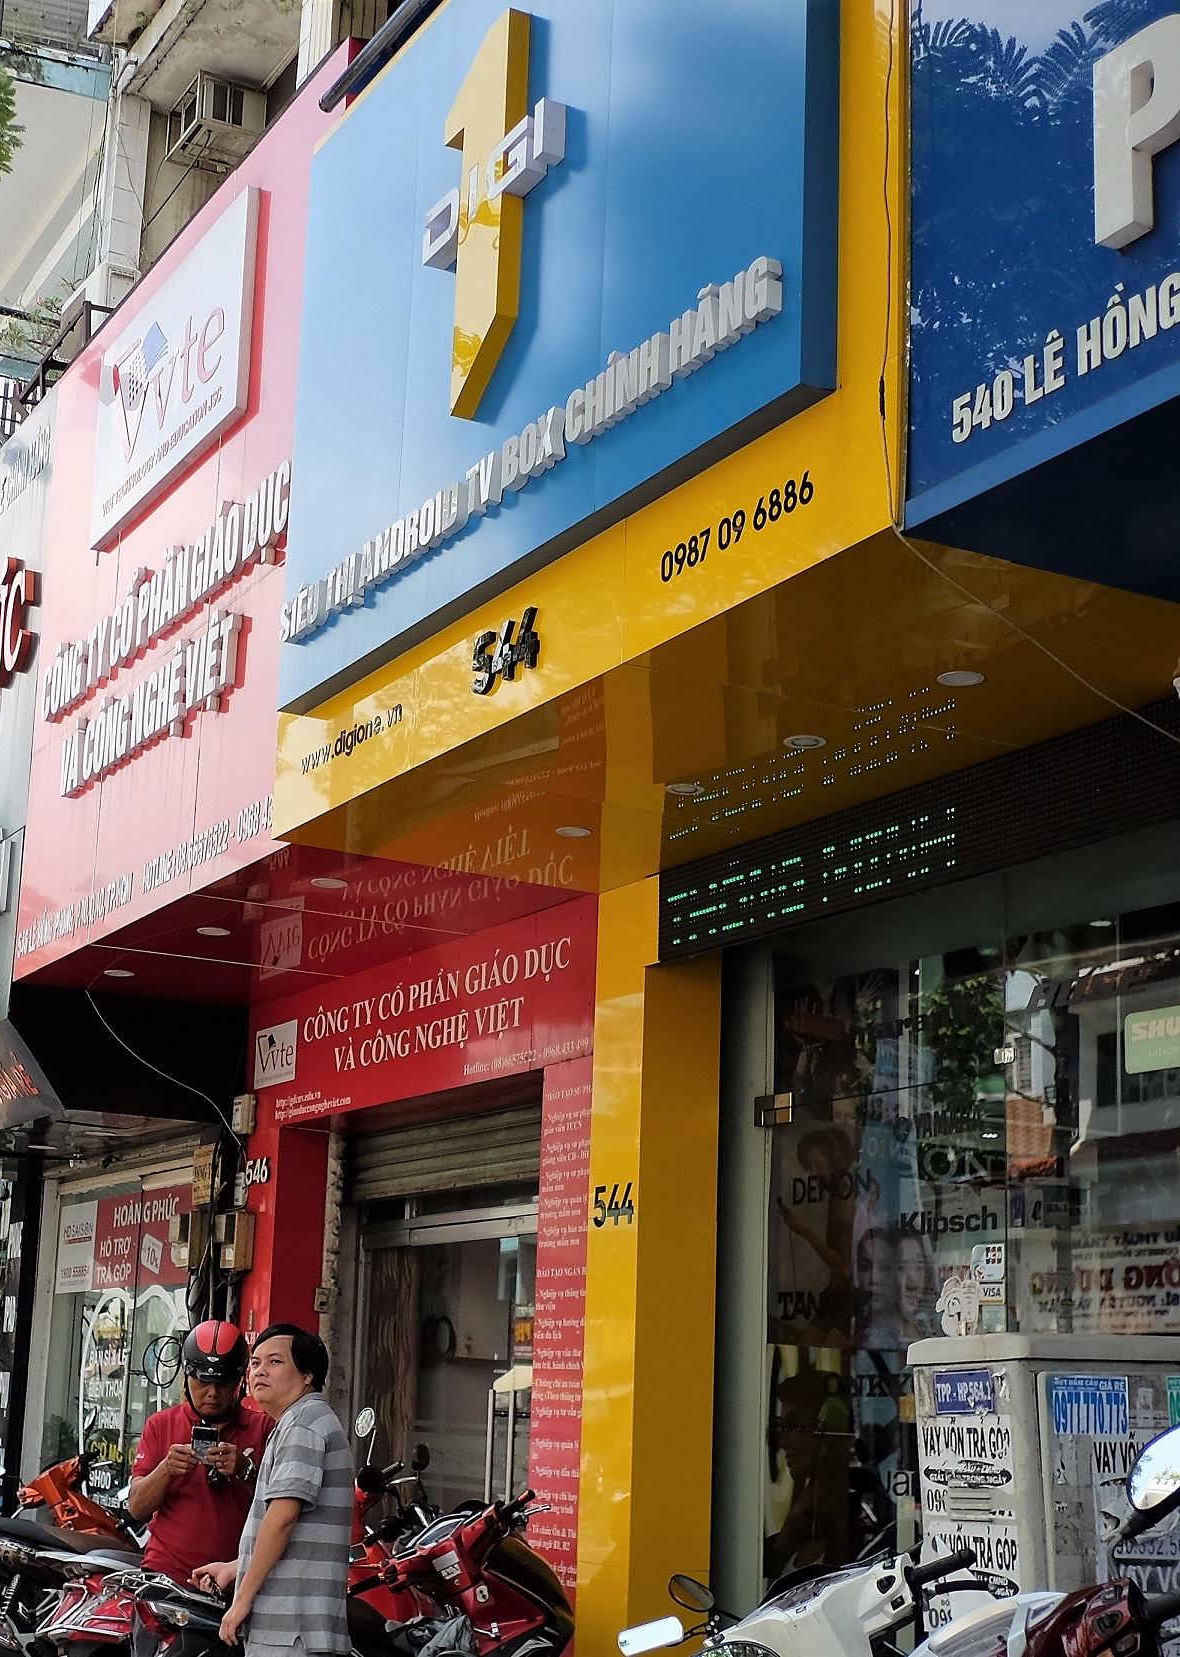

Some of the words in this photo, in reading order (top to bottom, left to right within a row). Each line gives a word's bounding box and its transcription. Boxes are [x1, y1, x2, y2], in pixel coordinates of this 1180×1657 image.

[422, 97, 567, 272] DIGI
[951, 383, 1015, 444] 540
[1020, 330, 1067, 406] LÊ
[325, 552, 365, 613] THỊ
[357, 481, 468, 588] ANDROID
[466, 450, 502, 516] TV
[501, 405, 566, 493] BOX
[565, 351, 671, 445] CHÍNH
[669, 255, 783, 378] HÃNG
[659, 532, 712, 583] 0987
[717, 511, 746, 552] 09
[753, 471, 815, 531] 6886
[41, 641, 89, 724] CÔNG
[85, 614, 114, 688] TY
[109, 566, 148, 668] CỔ
[135, 544, 194, 650] PHẦN
[190, 500, 246, 604] GIÁO
[241, 459, 290, 565] DỤC
[471, 606, 541, 696] 544
[60, 716, 89, 799] VÀ
[82, 693, 132, 782] CÔNG
[129, 638, 188, 750] NGHỆ
[183, 610, 242, 715] VIỆT
[303, 1004, 349, 1044] CÔNG
[353, 998, 377, 1028] TY
[378, 982, 405, 1019] CỔ
[408, 967, 460, 1012] PHẦN
[464, 947, 519, 997] GIÁO
[524, 937, 572, 982] DỤC
[333, 1036, 356, 1073] VÀ
[360, 1020, 411, 1063] CÔNG
[413, 1009, 470, 1050] NGHỆ
[475, 996, 525, 1041] VIỆT
[463, 1062, 490, 1076] Hotline:
[566, 1120, 582, 1132] TCCN
[245, 1156, 269, 1186] 546
[792, 1168, 873, 1207] DENON
[113, 1198, 151, 1228] HOÀNG
[151, 1193, 180, 1222] PHÚC
[592, 1180, 635, 1229] 544
[899, 1205, 998, 1241] Klipsch
[99, 1235, 113, 1258] HỖ
[113, 1236, 132, 1259] TRỢ
[96, 1261, 113, 1284] TRẢ
[113, 1259, 132, 1281] GÓP
[982, 1287, 1001, 1298] VISA
[1099, 1378, 1113, 1391] GIÁ
[1114, 1378, 1126, 1391] RẺ
[1054, 1391, 1128, 1434] 0977.770.773
[922, 1426, 941, 1457] VAY
[1093, 1441, 1117, 1473] VAY
[88, 1470, 112, 1490] 9H00
[994, 1527, 1018, 1571] GÓP
